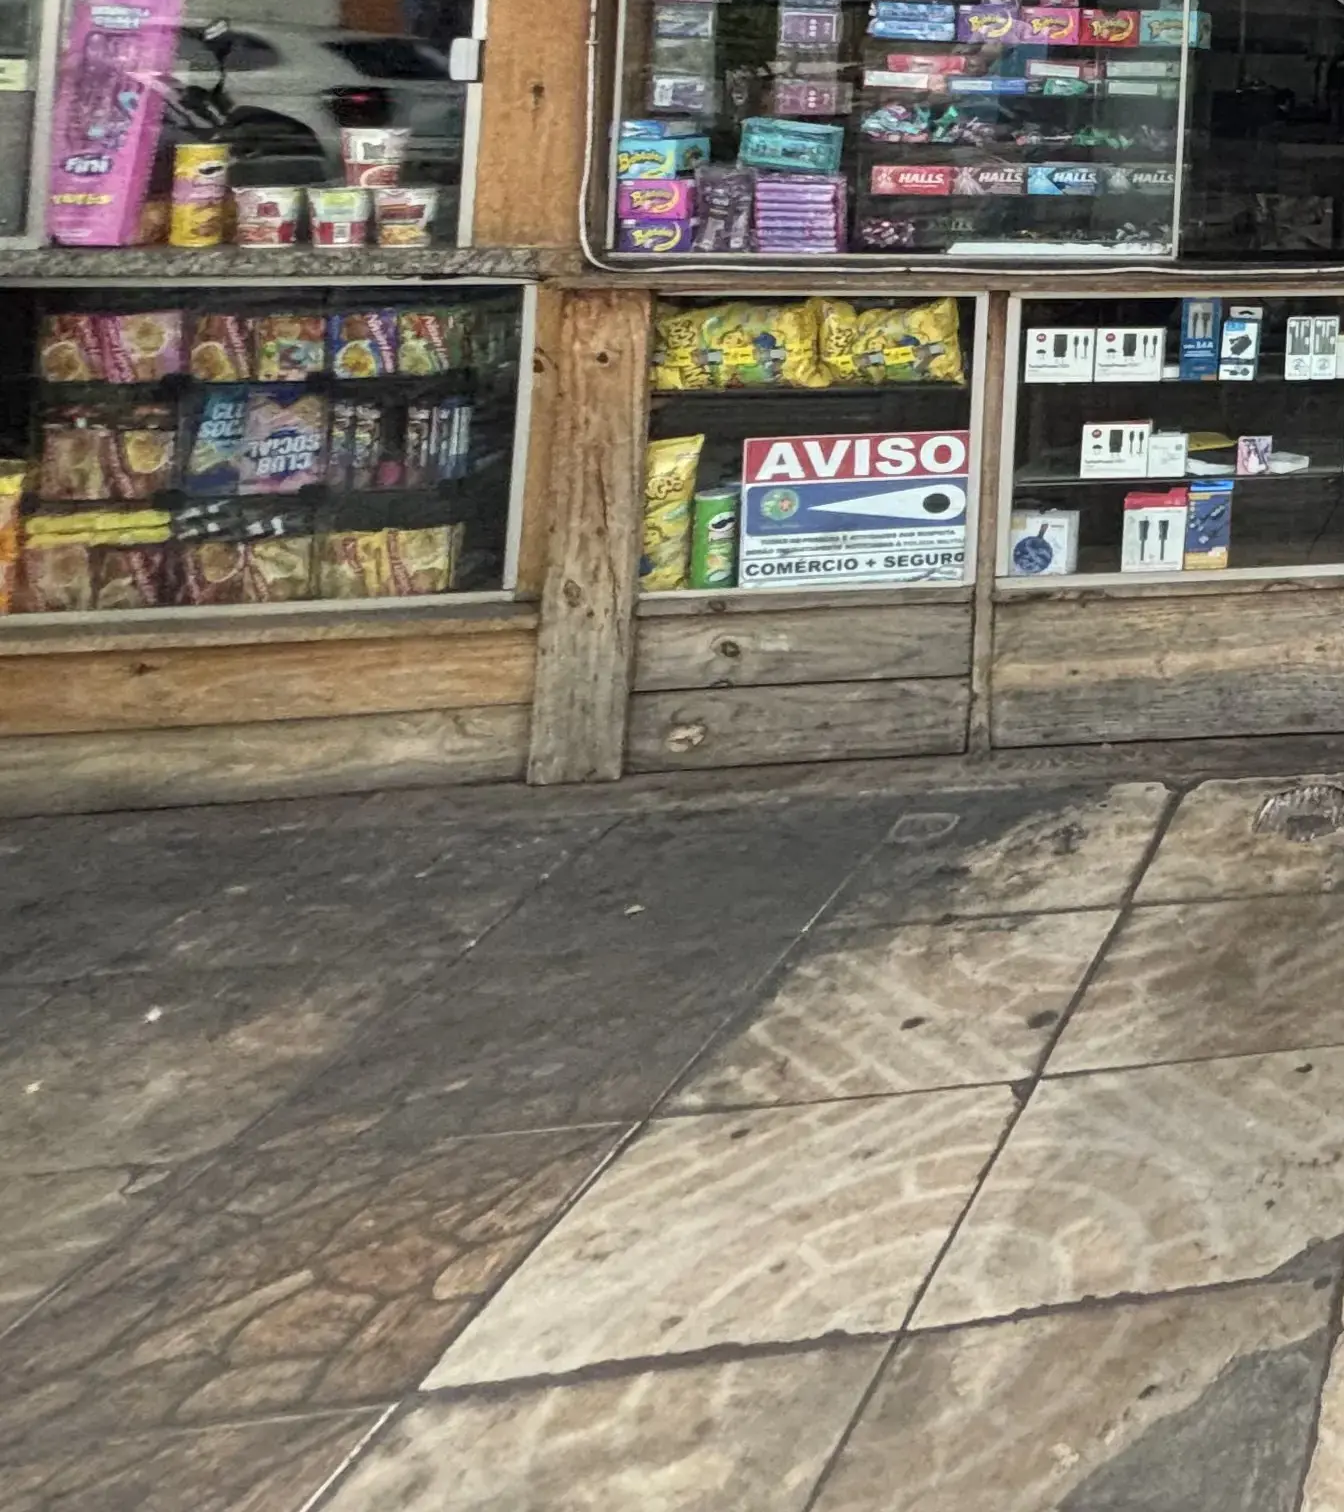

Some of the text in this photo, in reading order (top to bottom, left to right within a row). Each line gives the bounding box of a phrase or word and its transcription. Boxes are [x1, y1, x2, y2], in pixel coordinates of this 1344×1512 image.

[898, 172, 945, 185] HALLS
[978, 170, 1024, 184] HALLS
[1053, 170, 1098, 184] HALLS
[755, 435, 966, 482] AVISO
[745, 554, 859, 577] COMÉRCIO
[883, 551, 965, 569] SEGURO
